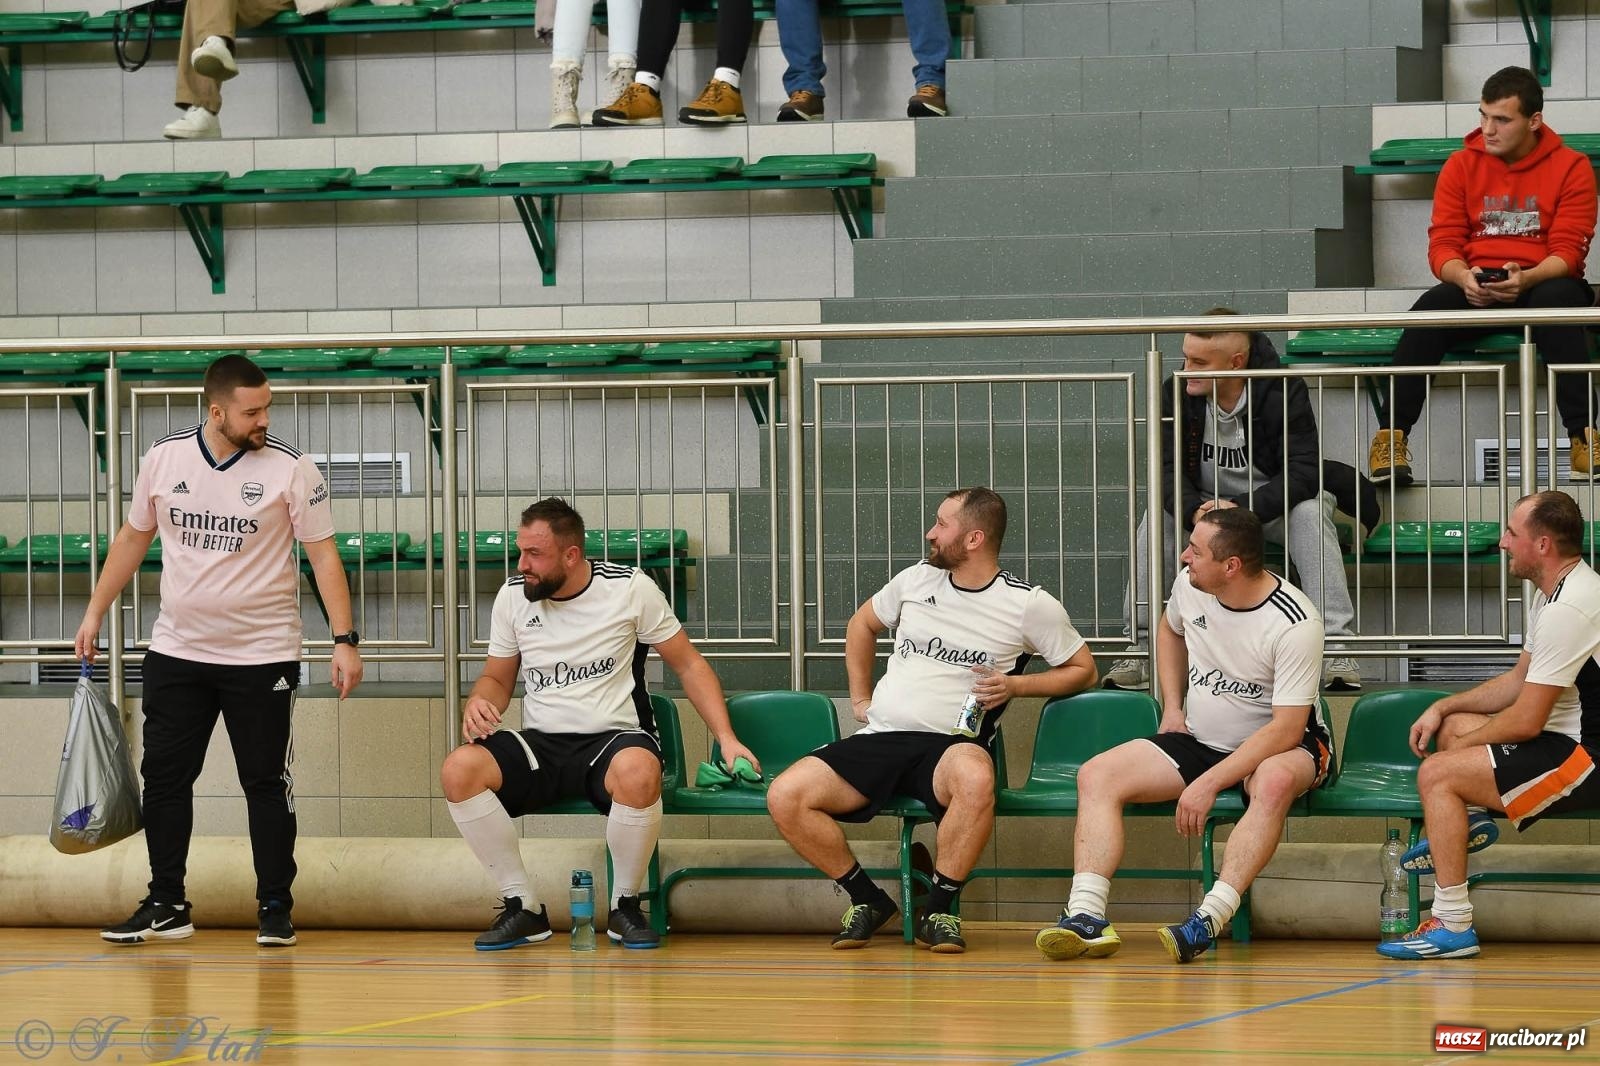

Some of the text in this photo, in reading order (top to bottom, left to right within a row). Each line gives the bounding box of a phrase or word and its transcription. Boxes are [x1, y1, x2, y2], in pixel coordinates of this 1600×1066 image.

[1202, 442, 1248, 469] PUM
[169, 507, 259, 534] Emirates
[182, 531, 244, 553] FLY BETTER
